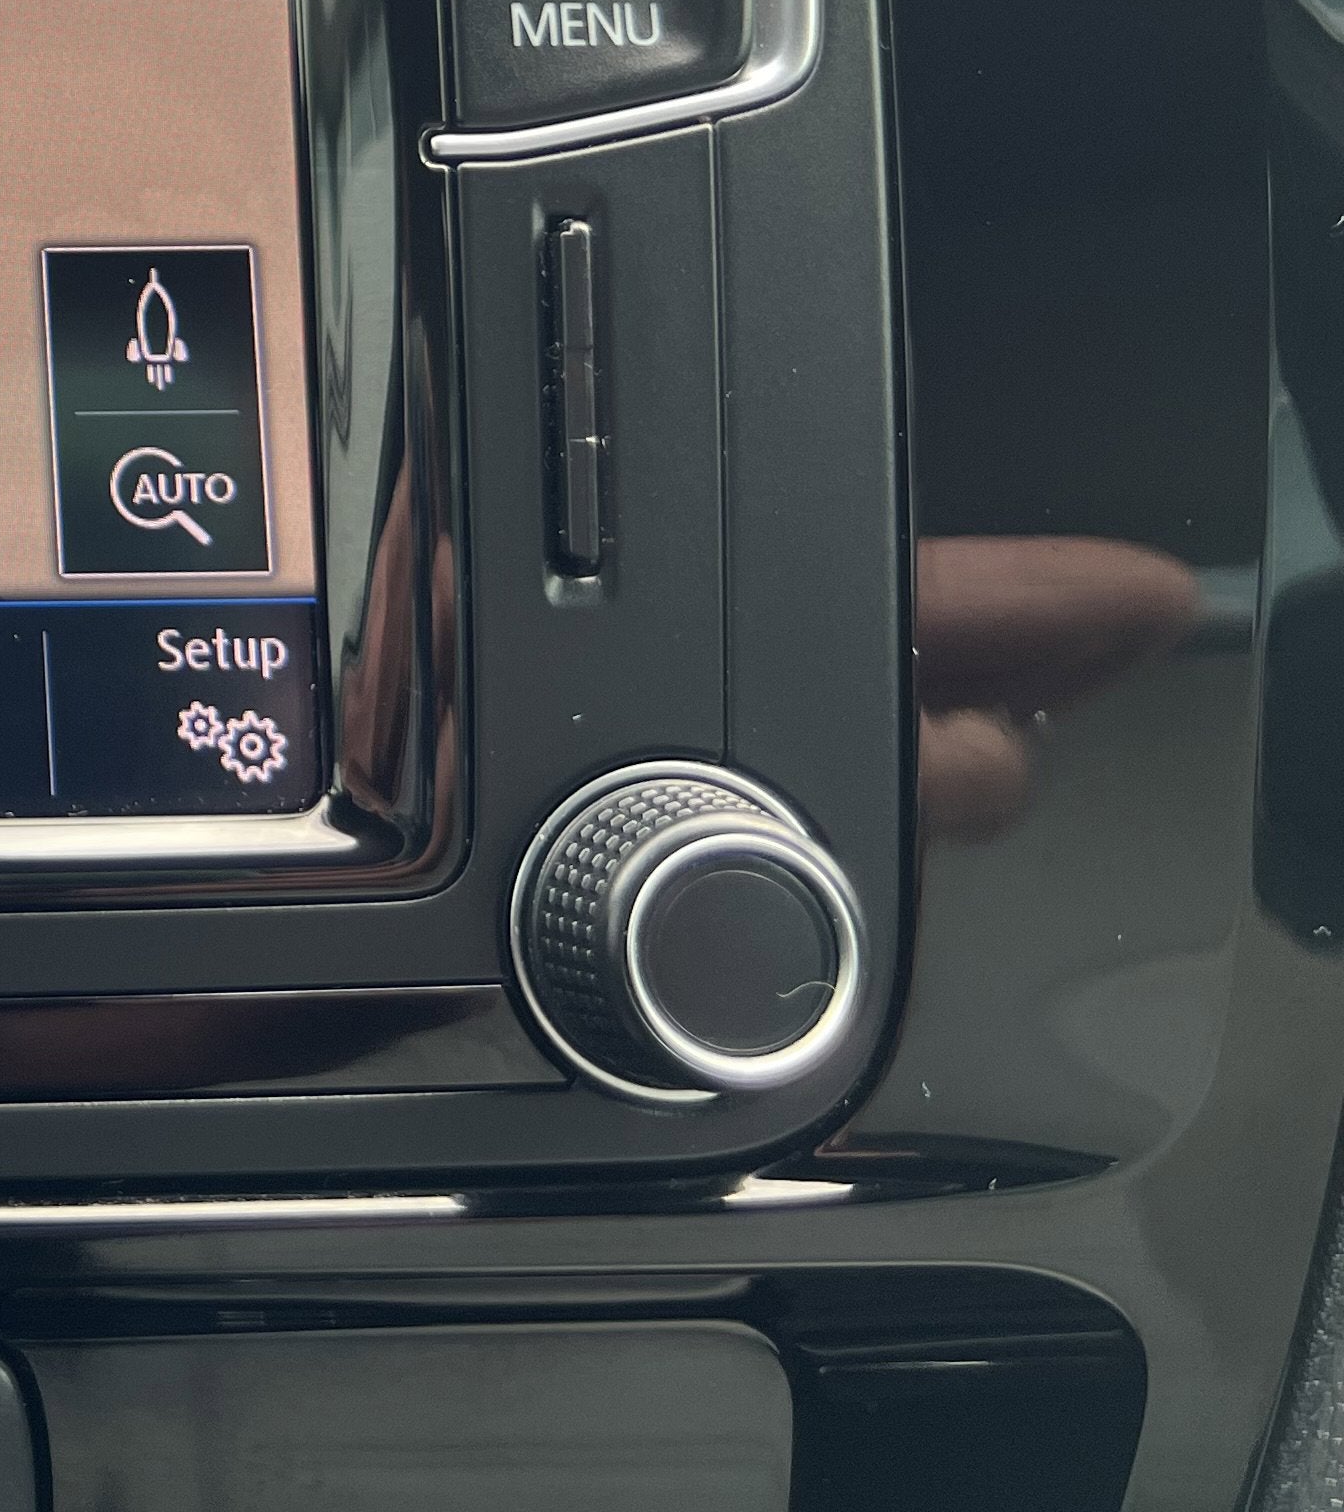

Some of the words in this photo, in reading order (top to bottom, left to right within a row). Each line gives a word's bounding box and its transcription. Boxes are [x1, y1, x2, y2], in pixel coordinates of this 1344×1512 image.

[510, 3, 661, 48] MENU
[132, 473, 235, 505] AUTO
[156, 628, 288, 679] Setup
